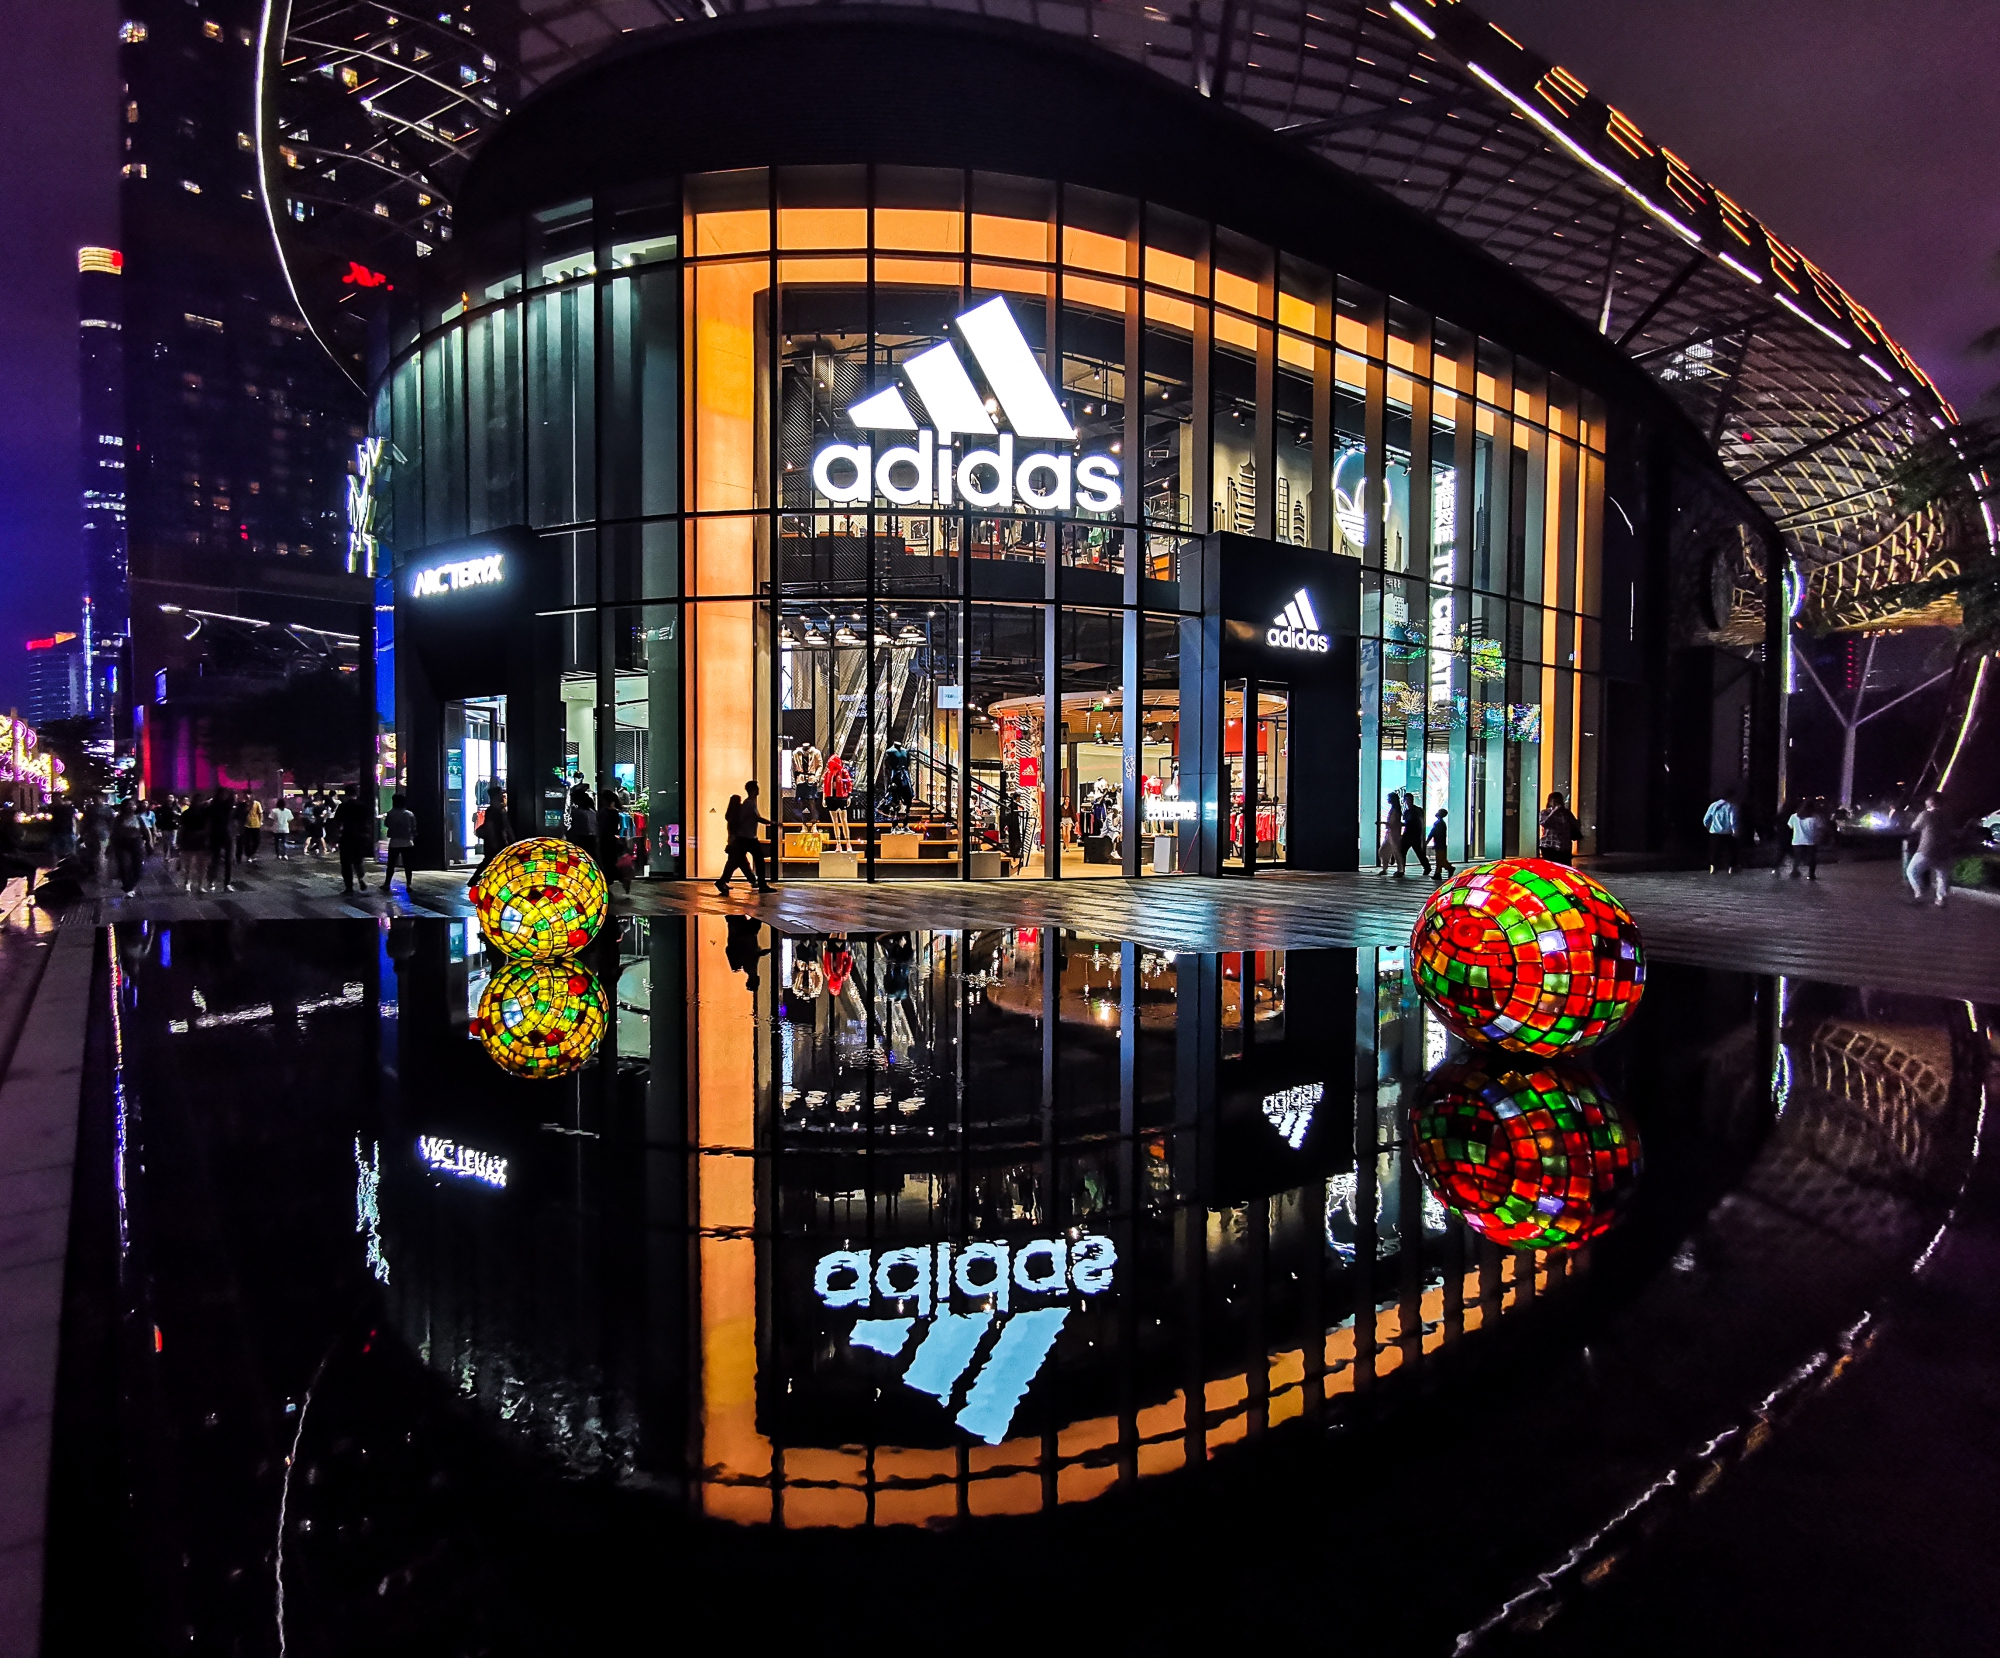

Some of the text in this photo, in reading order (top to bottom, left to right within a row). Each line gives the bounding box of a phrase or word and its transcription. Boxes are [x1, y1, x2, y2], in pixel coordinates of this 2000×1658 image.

[812, 428, 1123, 512] adidas
[1433, 469, 1455, 545] HERE
[1267, 626, 1329, 652] adidas
[1431, 597, 1453, 702] CREATE
